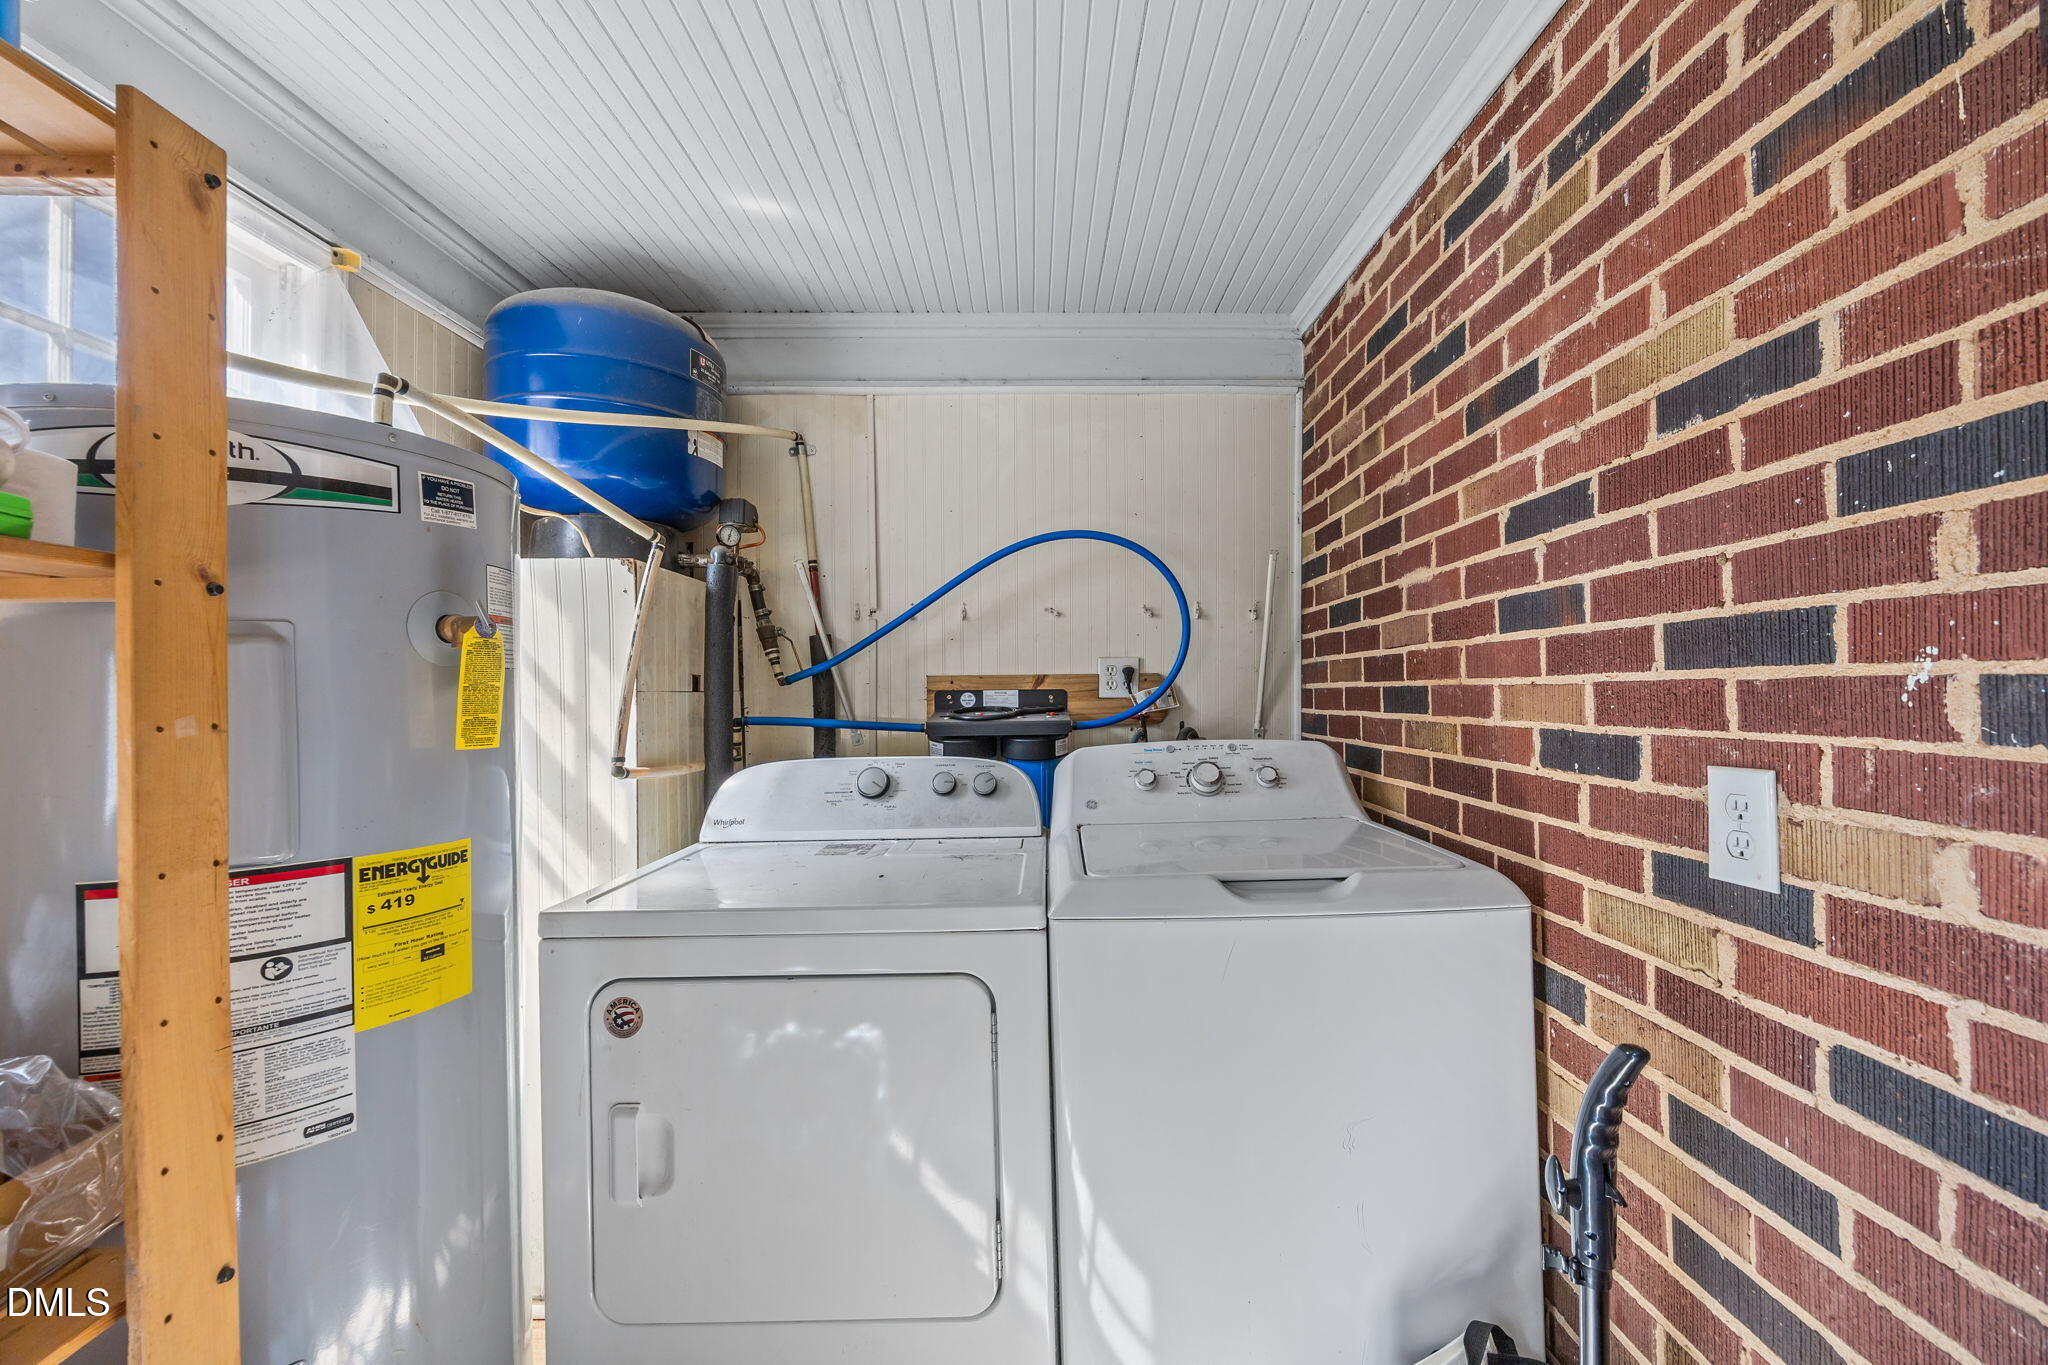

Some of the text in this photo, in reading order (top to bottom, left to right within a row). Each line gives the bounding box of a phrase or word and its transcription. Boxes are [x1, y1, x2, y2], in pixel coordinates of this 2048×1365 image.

[713, 817, 745, 829] Whirlpool
[377, 888, 402, 898] Estimated
[403, 885, 418, 894] Yearly
[380, 894, 416, 911] 419
[394, 931, 445, 948] First Hour Rating
[606, 998, 641, 1016] AMERICA
